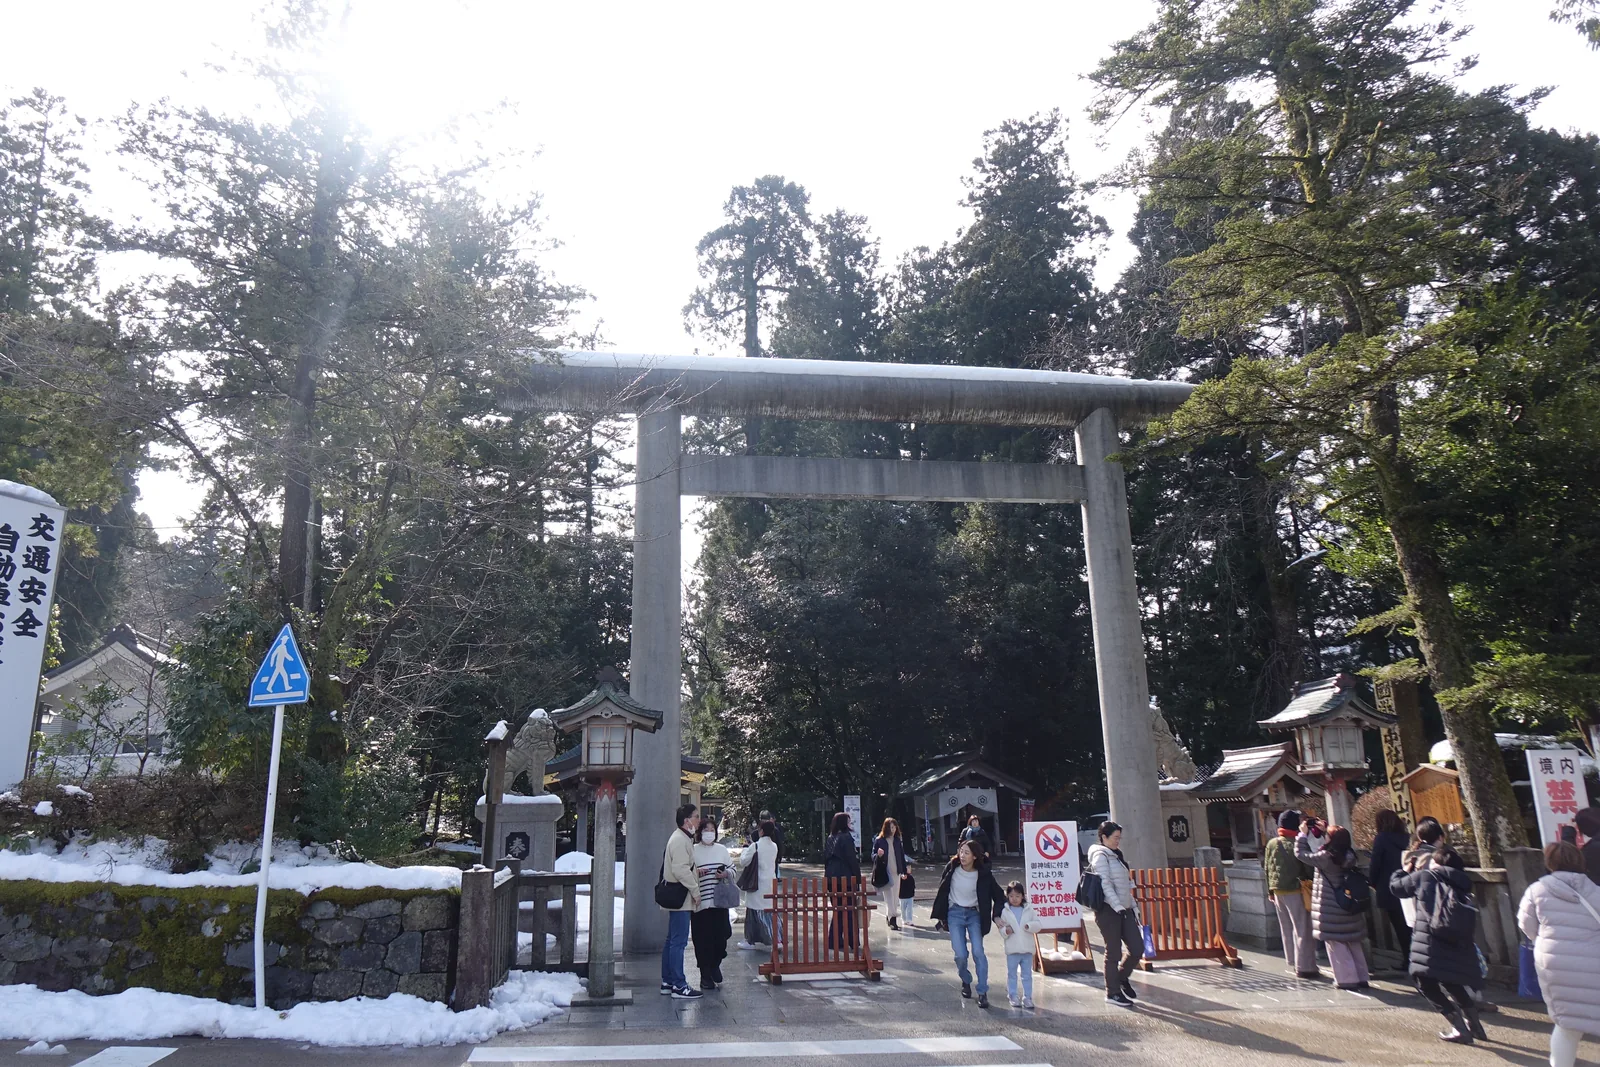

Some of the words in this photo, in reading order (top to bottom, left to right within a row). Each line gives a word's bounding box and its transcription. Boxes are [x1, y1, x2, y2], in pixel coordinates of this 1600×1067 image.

[11, 512, 56, 639] 交通安全
[1538, 757, 1575, 775] 境内
[1031, 871, 1065, 879] これより先
[1030, 880, 1063, 891] ペットを
